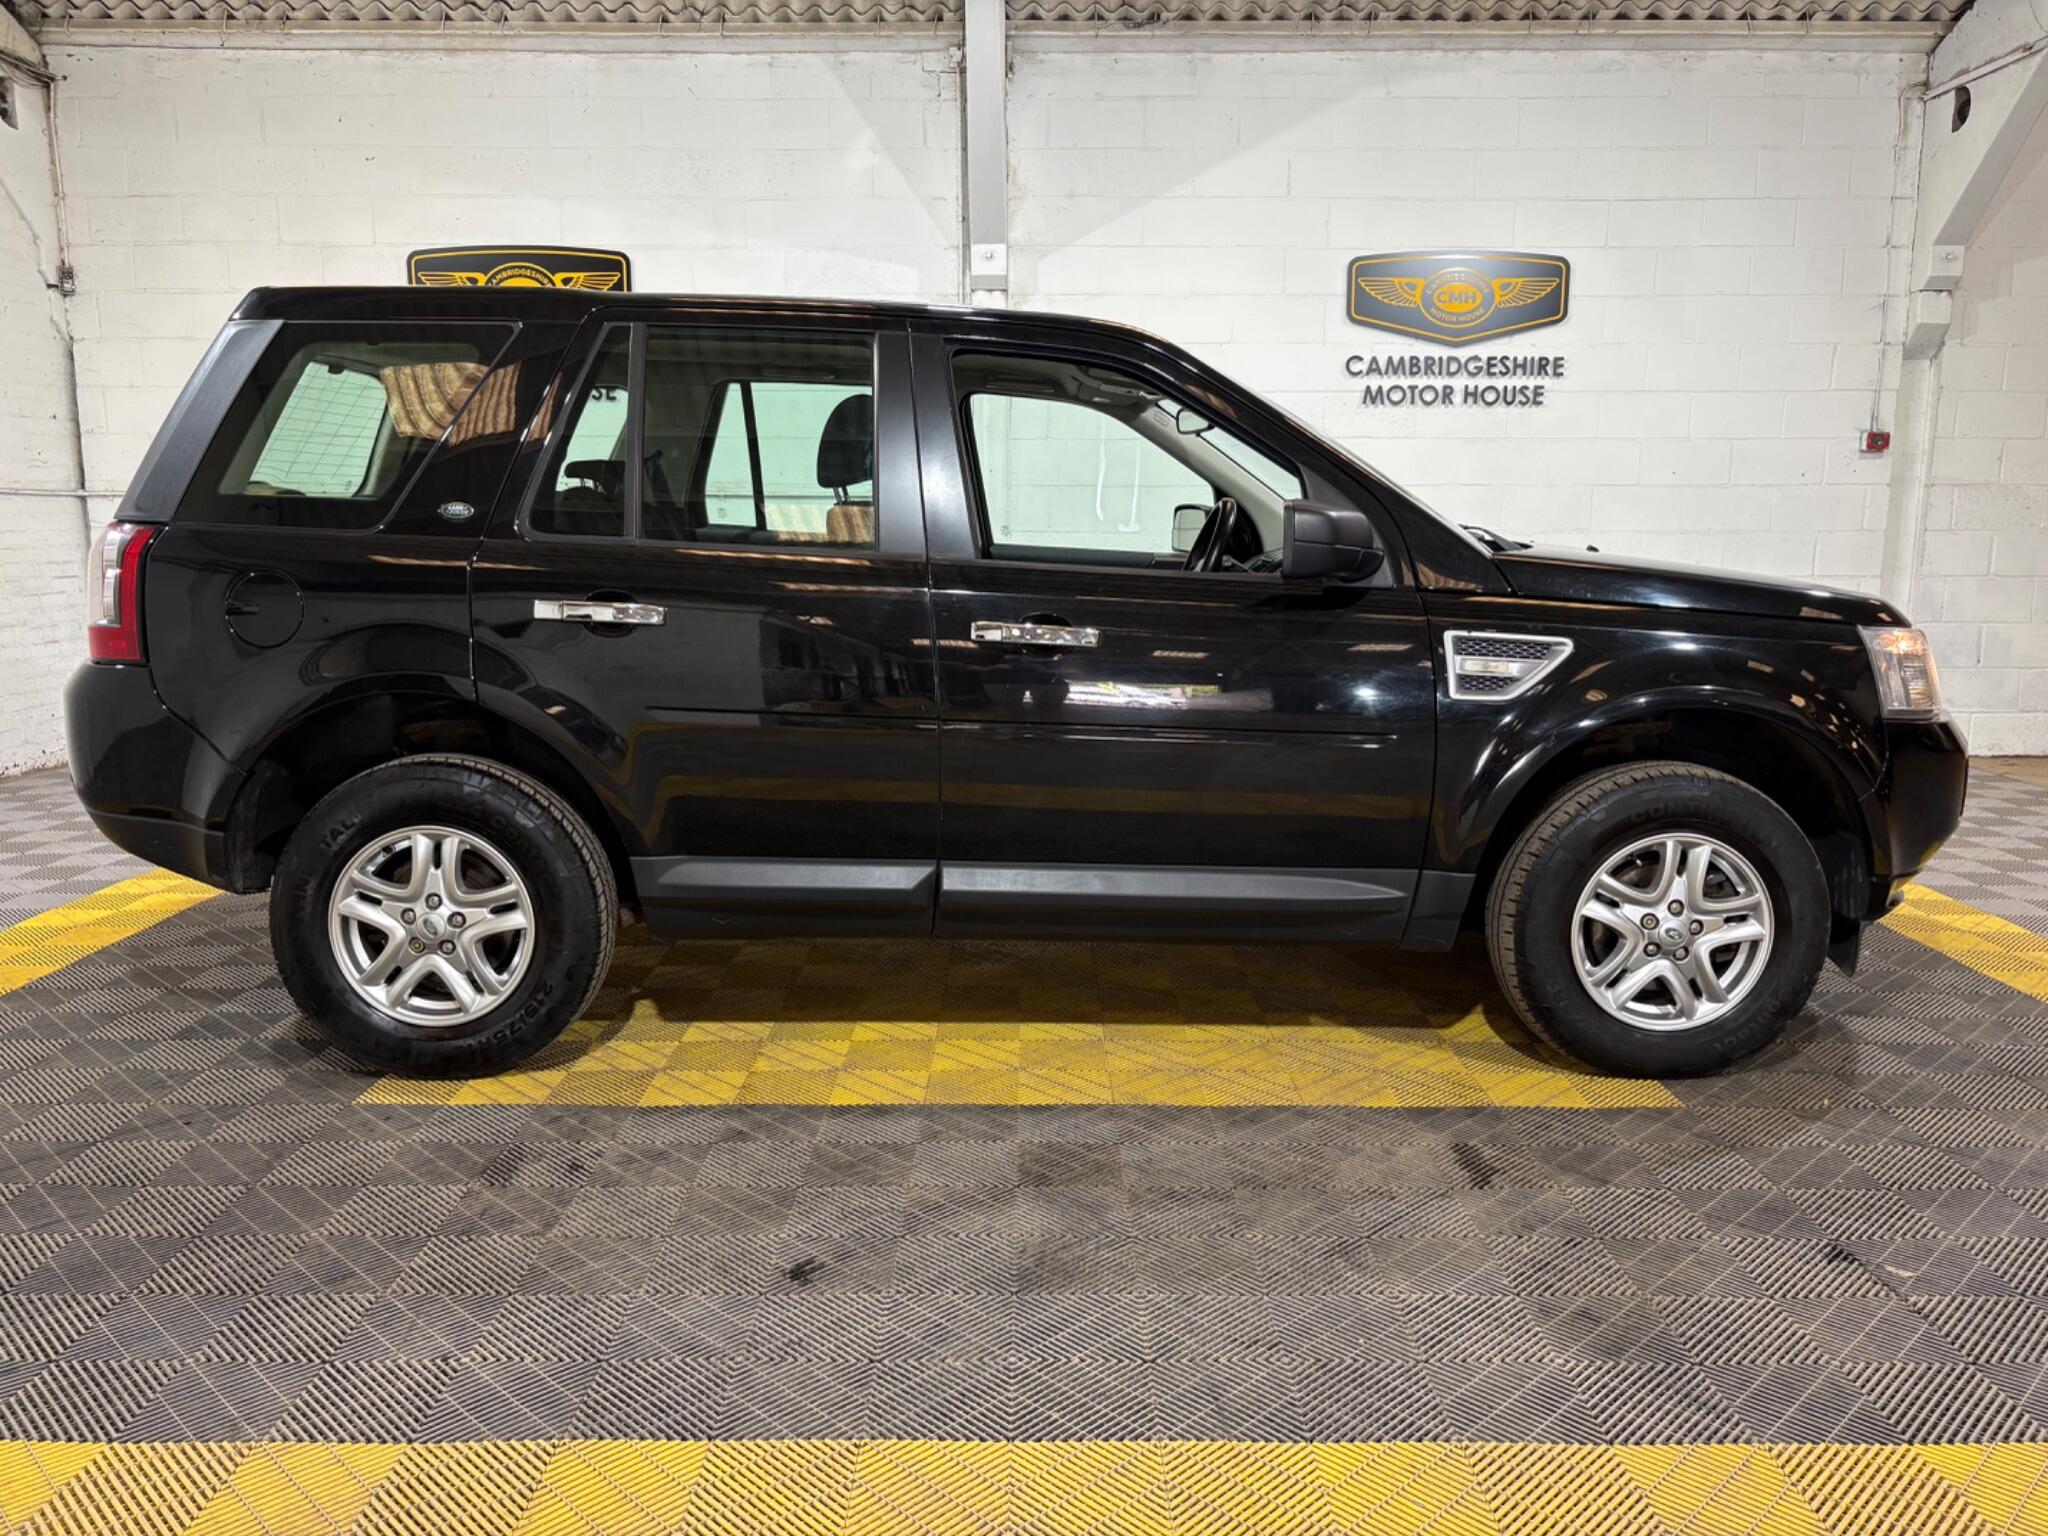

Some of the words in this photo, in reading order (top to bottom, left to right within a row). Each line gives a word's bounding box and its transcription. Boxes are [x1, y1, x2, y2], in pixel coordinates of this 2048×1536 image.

[1437, 290, 1477, 305] CMH
[1345, 355, 1565, 377] CAMBRIDGESHIRE
[1362, 384, 1454, 406] MOTOR
[1463, 384, 1546, 406] HOUSE
